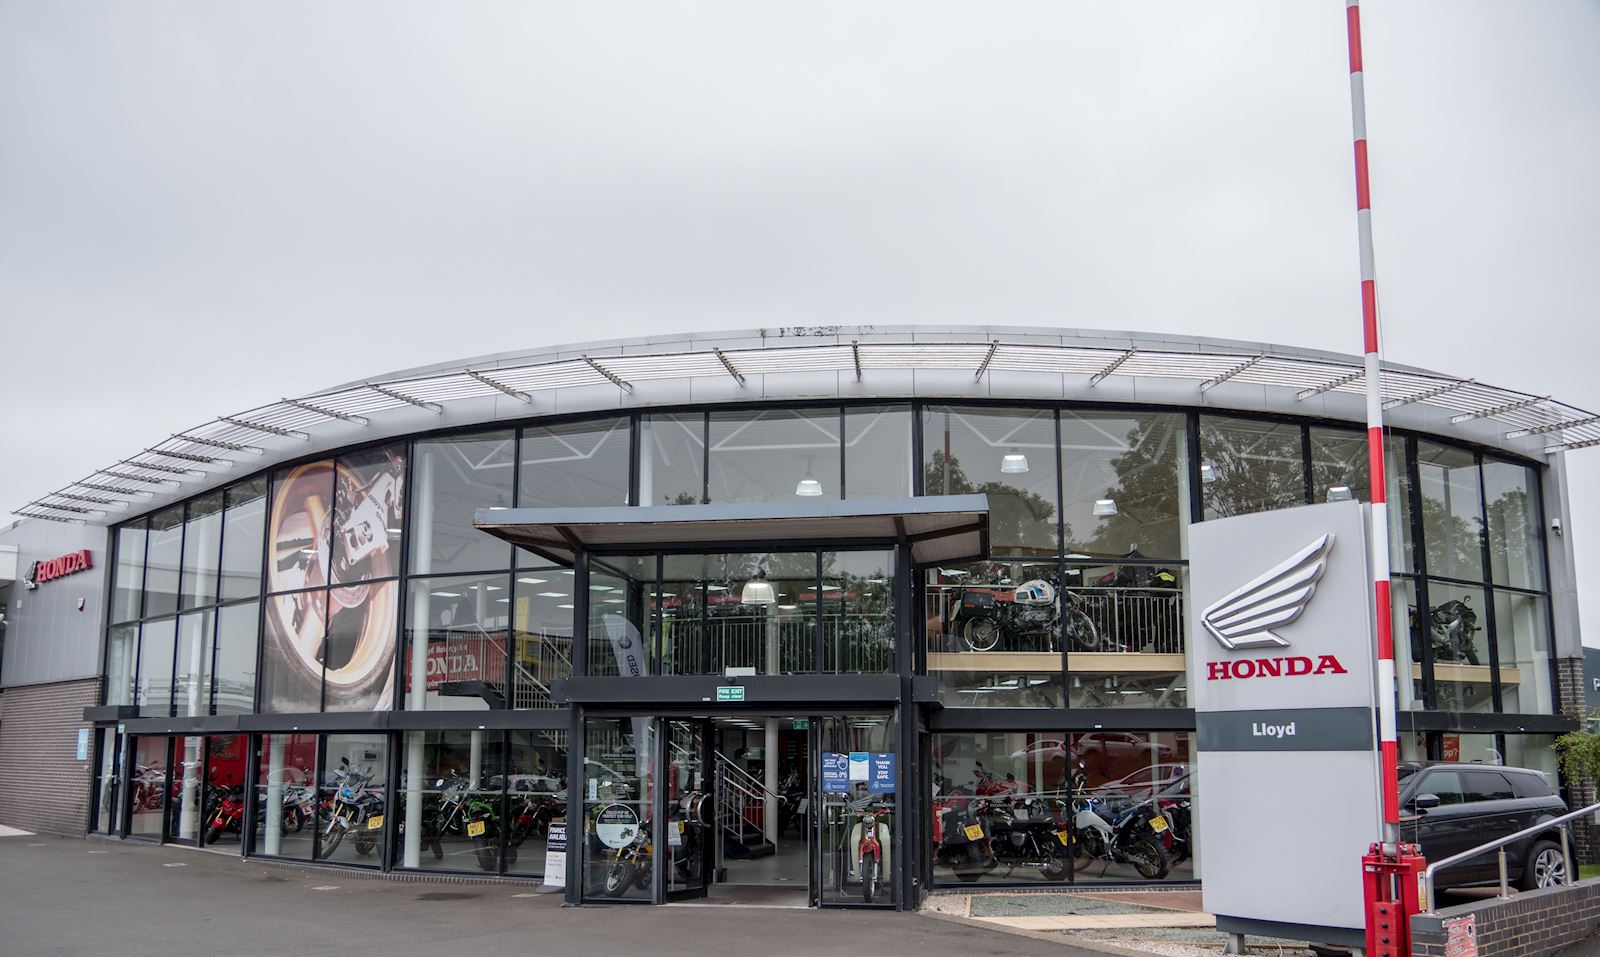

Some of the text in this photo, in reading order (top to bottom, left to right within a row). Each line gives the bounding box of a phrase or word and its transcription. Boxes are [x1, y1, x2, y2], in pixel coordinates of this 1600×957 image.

[36, 549, 92, 583] HONDA
[411, 653, 479, 677] ONDA
[1207, 655, 1348, 681] HONDA
[1252, 721, 1296, 738] Lloyd
[1443, 748, 1458, 758] pp?
[549, 833, 567, 841] AVAILABL
